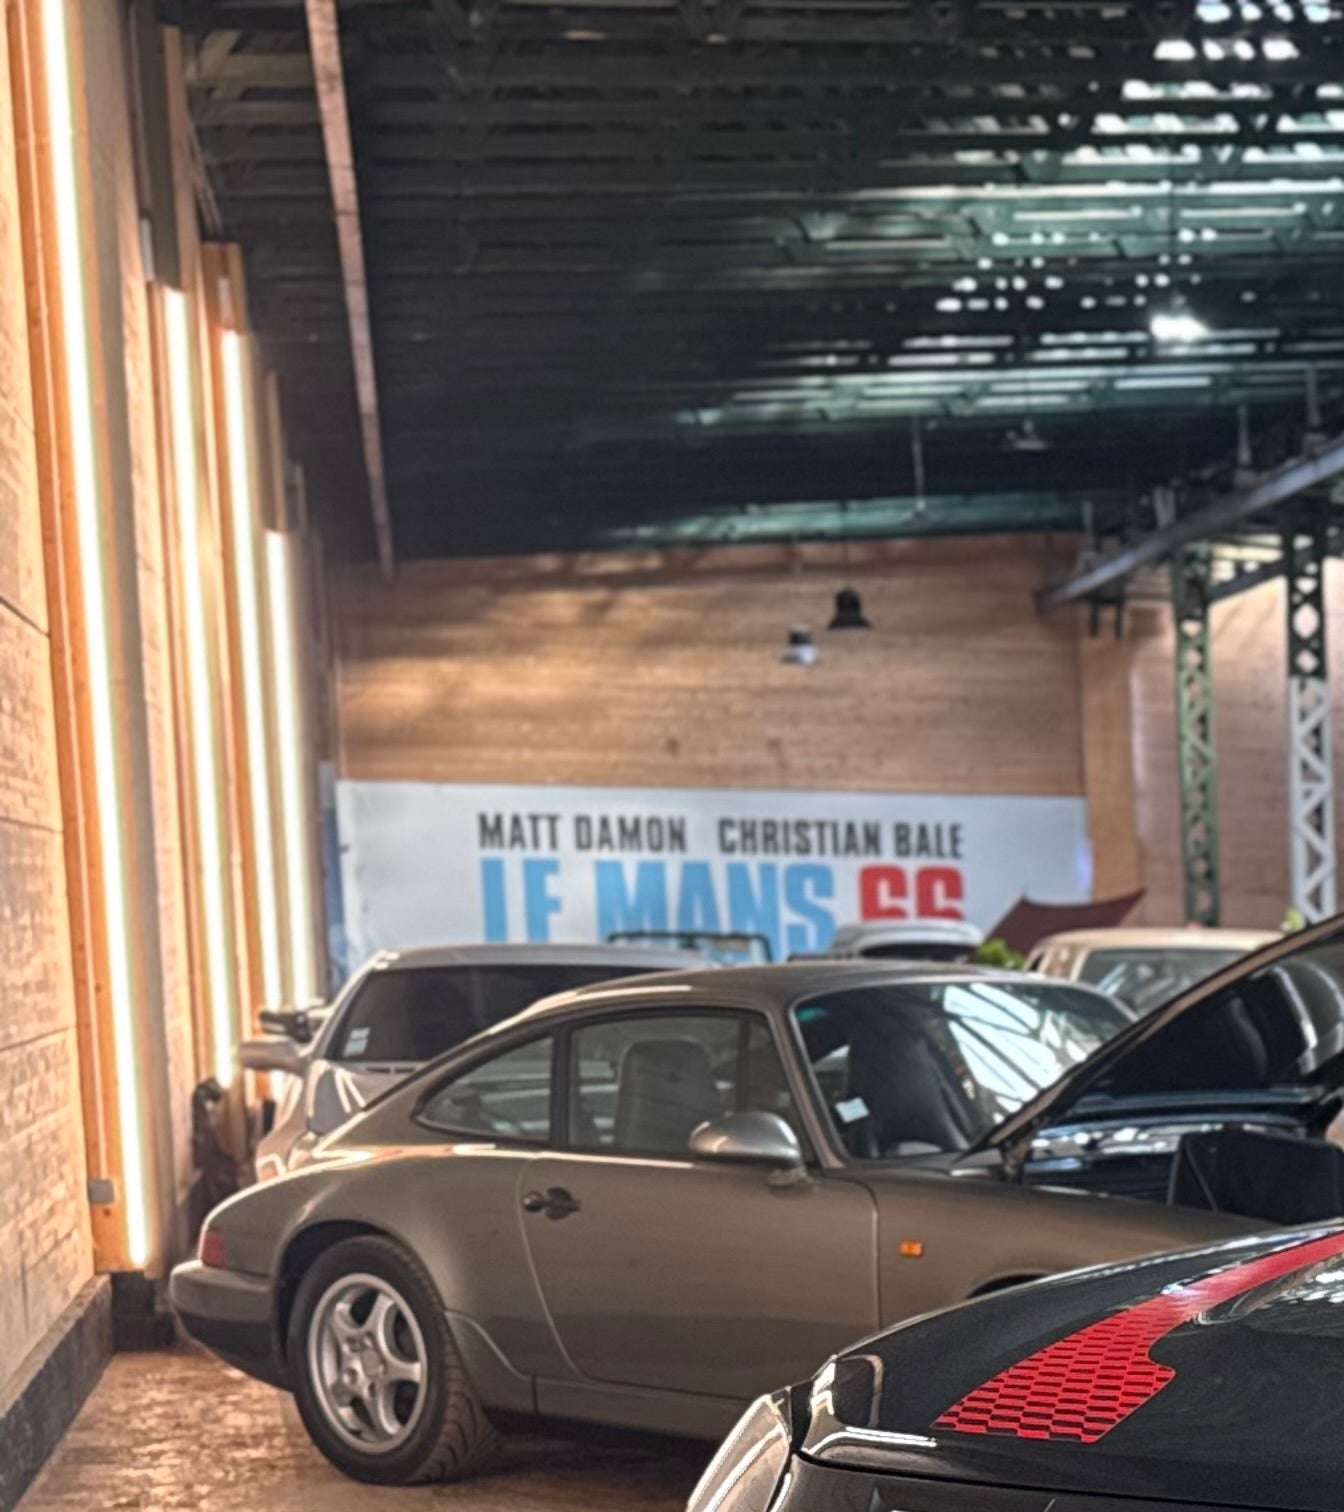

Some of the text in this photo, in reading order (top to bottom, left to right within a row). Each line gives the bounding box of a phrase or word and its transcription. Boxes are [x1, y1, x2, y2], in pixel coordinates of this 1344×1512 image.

[478, 813, 963, 859] MATT DAMON CHRISTIAN BALE
[594, 860, 835, 964] MANS
